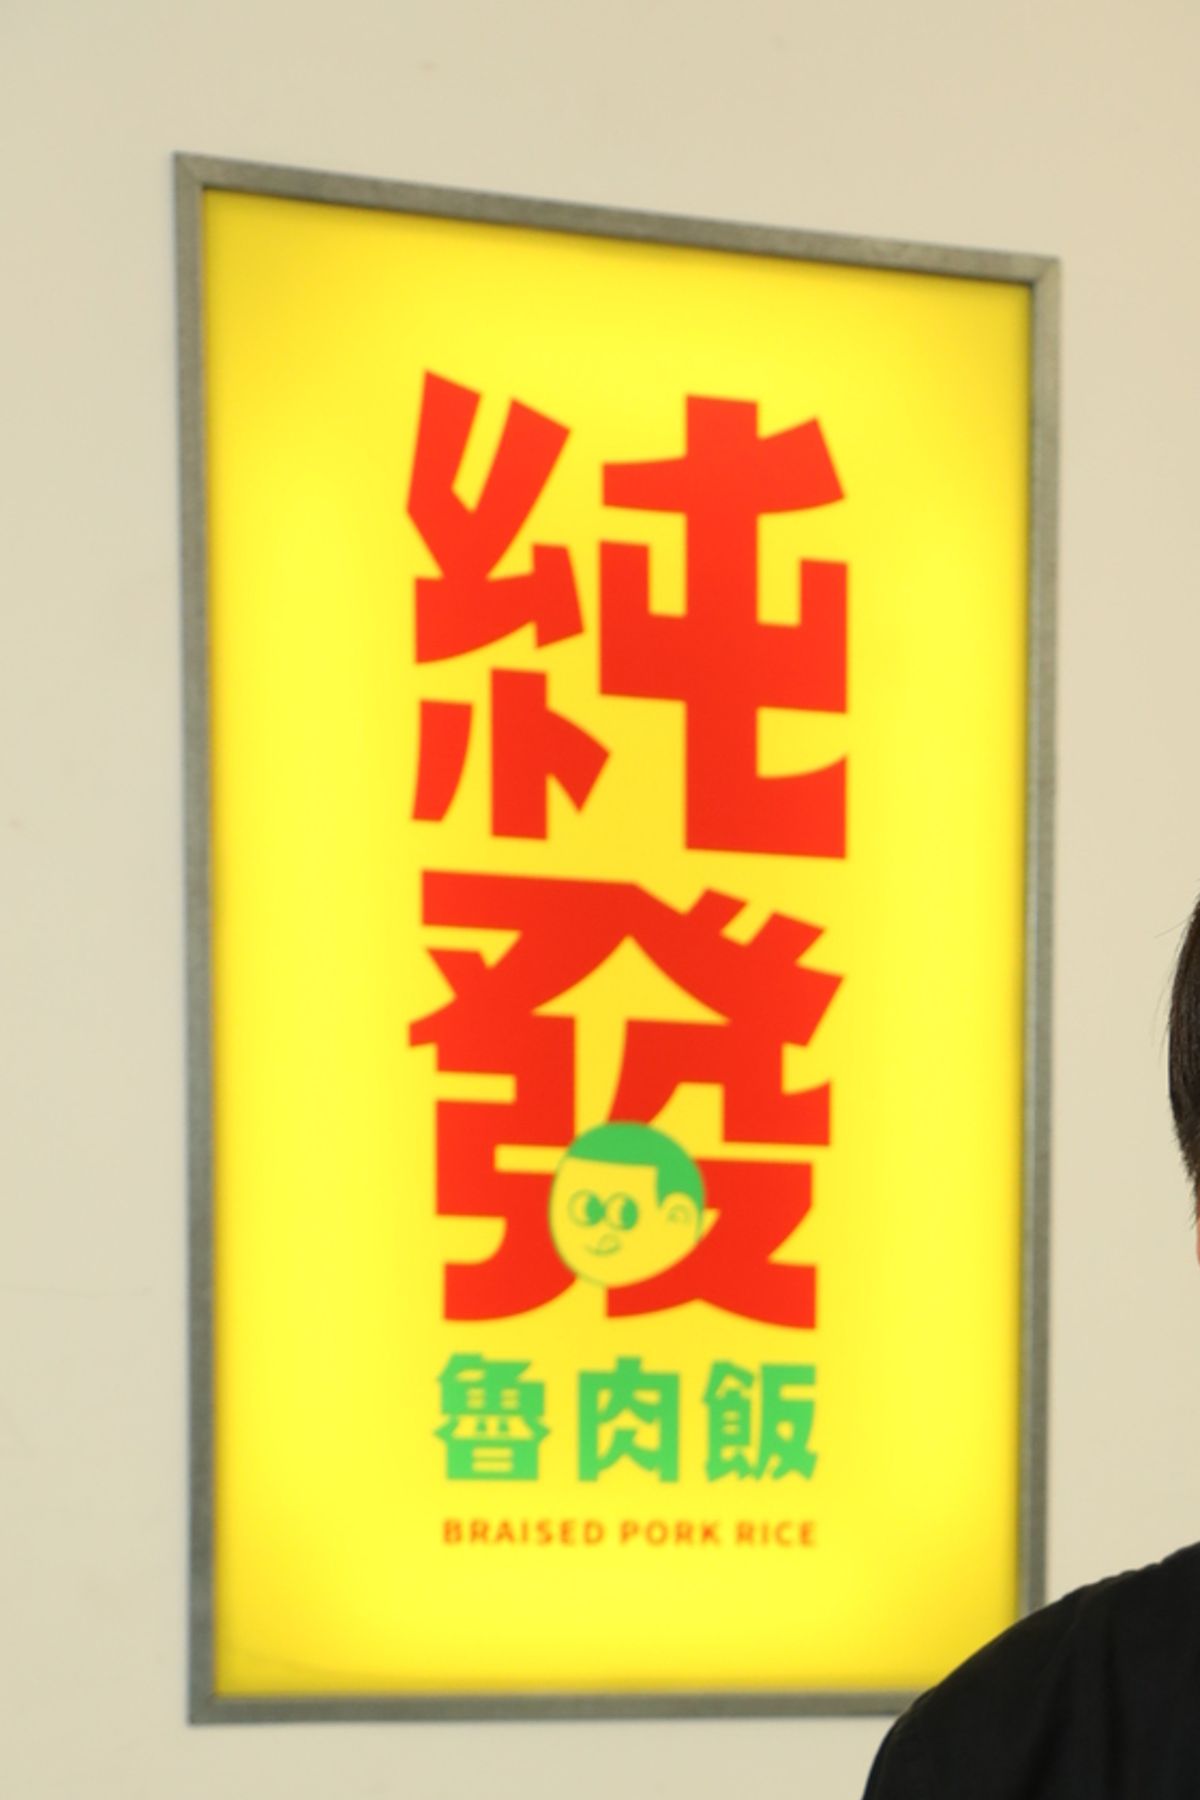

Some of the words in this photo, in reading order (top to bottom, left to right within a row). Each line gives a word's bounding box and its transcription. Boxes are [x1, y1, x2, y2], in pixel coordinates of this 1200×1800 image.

[406, 370, 849, 1331] 純發
[434, 1352, 818, 1483] 魯肉飯
[442, 1518, 606, 1547] BRAISED
[619, 1519, 721, 1547] PORK
[735, 1520, 818, 1548] RICE
